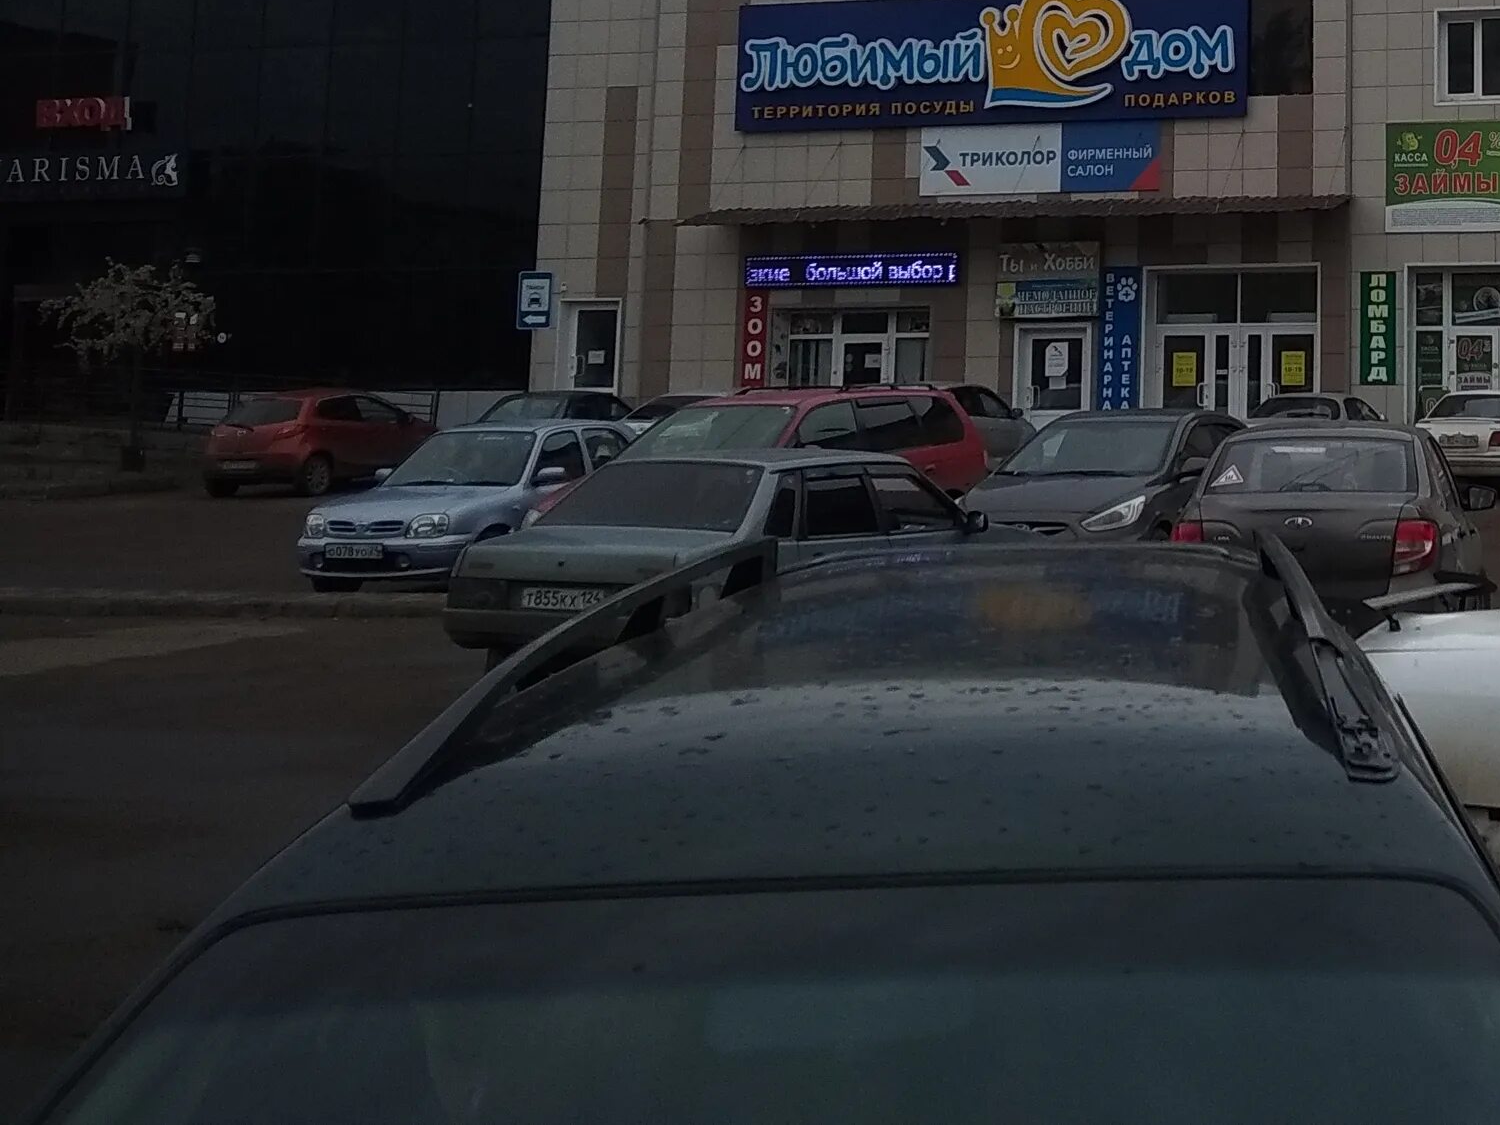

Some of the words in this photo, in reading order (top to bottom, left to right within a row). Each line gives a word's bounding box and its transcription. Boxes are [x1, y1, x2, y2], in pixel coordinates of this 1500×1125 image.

[740, 30, 984, 93] Любимый
[751, 102, 882, 120] ТЕРРИТОРИЯ
[890, 99, 976, 117] ПОСУДЫ
[1123, 89, 1237, 109] ПОДАРКОВ
[959, 148, 1058, 169] ТРИКОЛОР
[1066, 144, 1153, 162] ФИРМЕННЫЙ
[1394, 152, 1429, 163] КАССА
[0, 154, 145, 183] ARISMA
[1066, 162, 1115, 178] САЛОН
[1394, 168, 1499, 195] ЗАЙМЫ
[743, 295, 763, 380] ЗООМ
[1367, 273, 1388, 383] ЛОМБАРД
